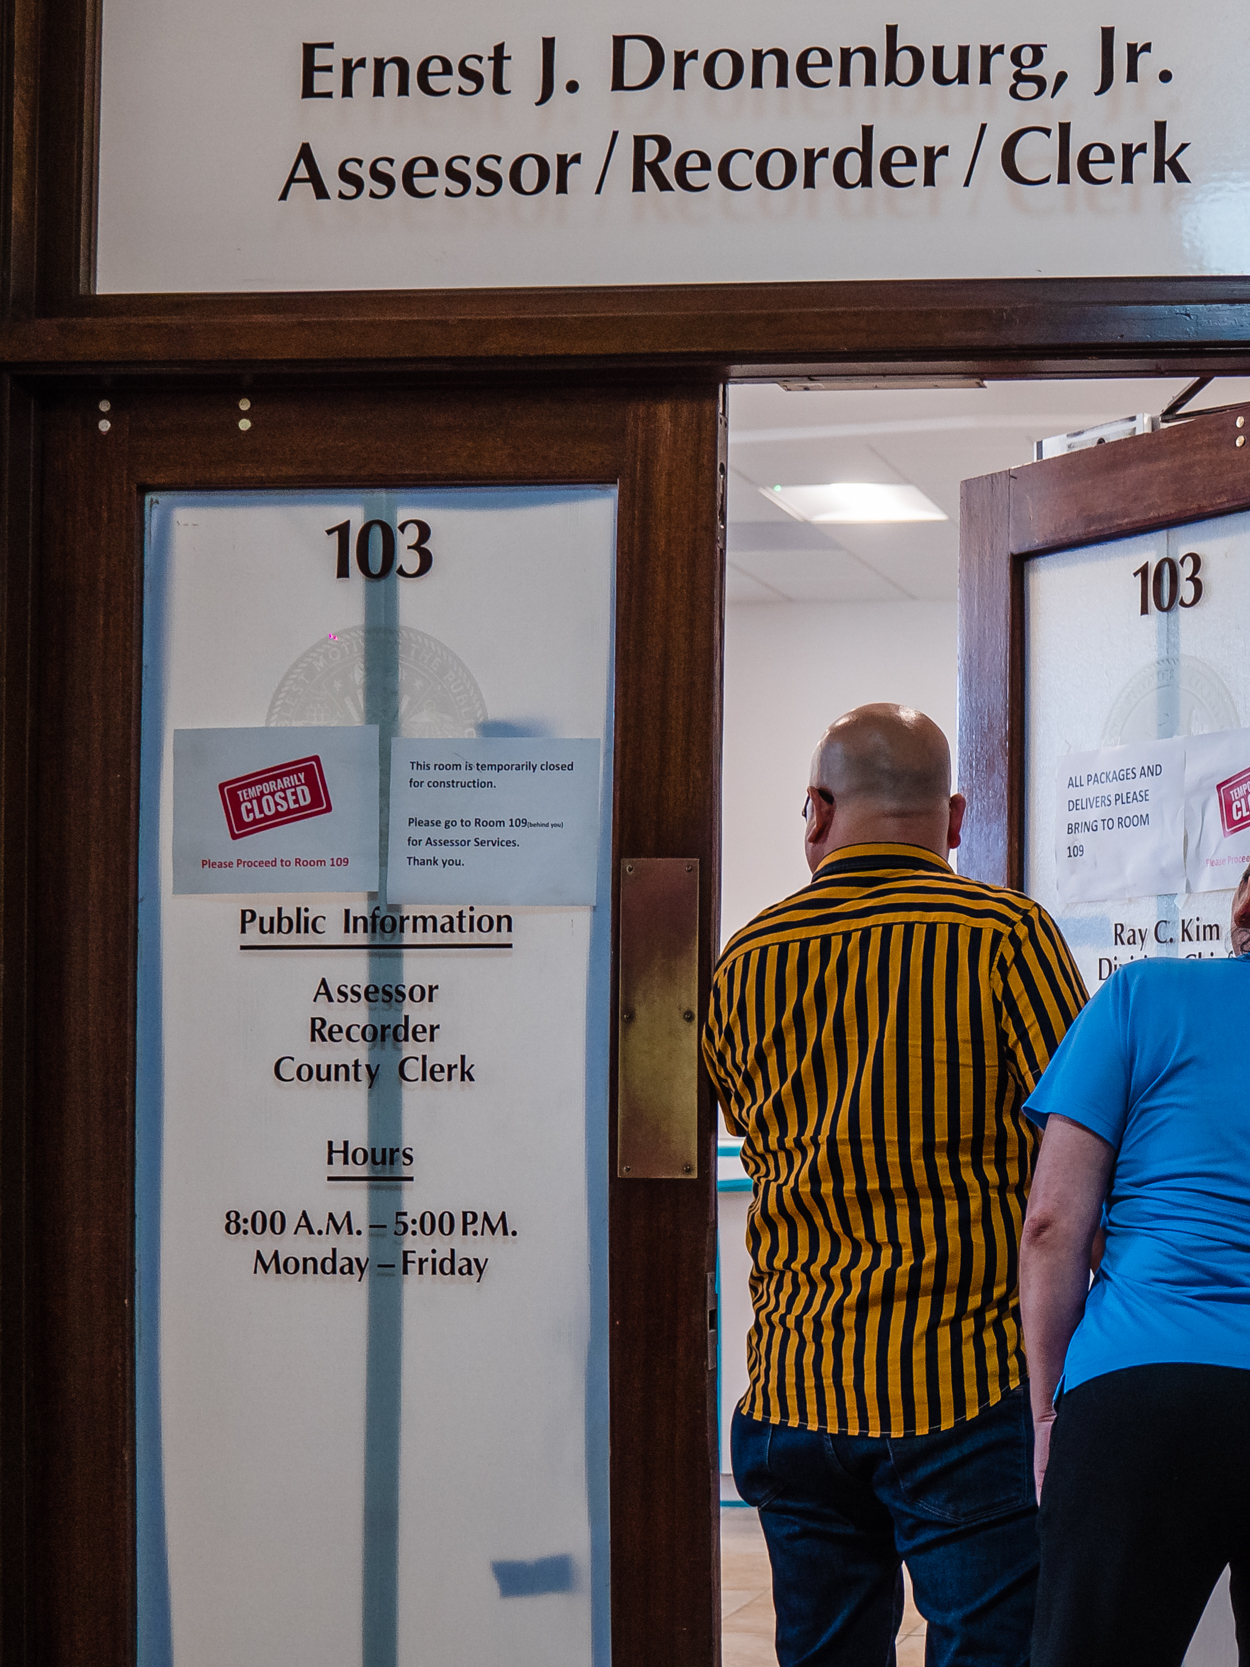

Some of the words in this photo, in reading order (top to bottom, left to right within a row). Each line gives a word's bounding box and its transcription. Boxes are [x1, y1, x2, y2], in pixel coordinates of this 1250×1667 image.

[300, 41, 511, 100] Ernest
[535, 36, 580, 106] J.
[611, 24, 1070, 102] Dronenburg,
[1094, 26, 1174, 97] Jr.
[325, 519, 434, 579] 103
[1132, 551, 1204, 617] 103
[410, 761, 431, 771] This
[433, 763, 462, 771] room
[465, 761, 474, 771] is
[475, 761, 537, 773] temporarily
[540, 761, 574, 771] closed
[1067, 775, 1084, 789] ALL
[1087, 767, 1137, 786] PACKAGES
[1139, 764, 1163, 779] AND
[237, 772, 305, 801] TEMPORARILY
[409, 778, 424, 788] for
[427, 779, 497, 789] construction.
[240, 785, 312, 823] CLOSED
[1068, 794, 1112, 812] DELIVERS
[1115, 789, 1150, 806] PLEASE
[408, 817, 441, 827] Please
[444, 820, 458, 829] go
[460, 818, 472, 827] to
[474, 818, 505, 828] Room
[1067, 820, 1098, 835] BRING
[1101, 818, 1115, 831] TO
[1117, 813, 1150, 829] ROOM
[407, 837, 423, 847] for
[425, 837, 471, 847] Assessor
[474, 837, 520, 847] Services.
[1067, 845, 1084, 858] 109
[201, 859, 234, 869] Please
[236, 857, 277, 868] Proceed
[280, 859, 291, 868] to
[294, 858, 326, 867] Room
[330, 857, 349, 867] 109
[407, 856, 439, 866] Thank
[442, 858, 465, 868] you.
[1205, 858, 1226, 867] Please
[240, 907, 326, 935] Public
[343, 906, 514, 935] Information
[1114, 923, 1148, 951] Ray
[1154, 920, 1174, 944] C.
[1181, 917, 1220, 942] Kim
[313, 977, 439, 1003] Assessor
[309, 1015, 440, 1043] Recorder
[273, 1056, 380, 1088] County
[398, 1054, 476, 1083] Clerk
[326, 1140, 414, 1166] Hours
[224, 1210, 286, 1236] 8:00
[293, 1211, 363, 1236] A.M.
[393, 1211, 455, 1237] 5:00
[461, 1211, 518, 1237] P.M.
[252, 1248, 370, 1282] Monday
[401, 1249, 489, 1282] Friday
